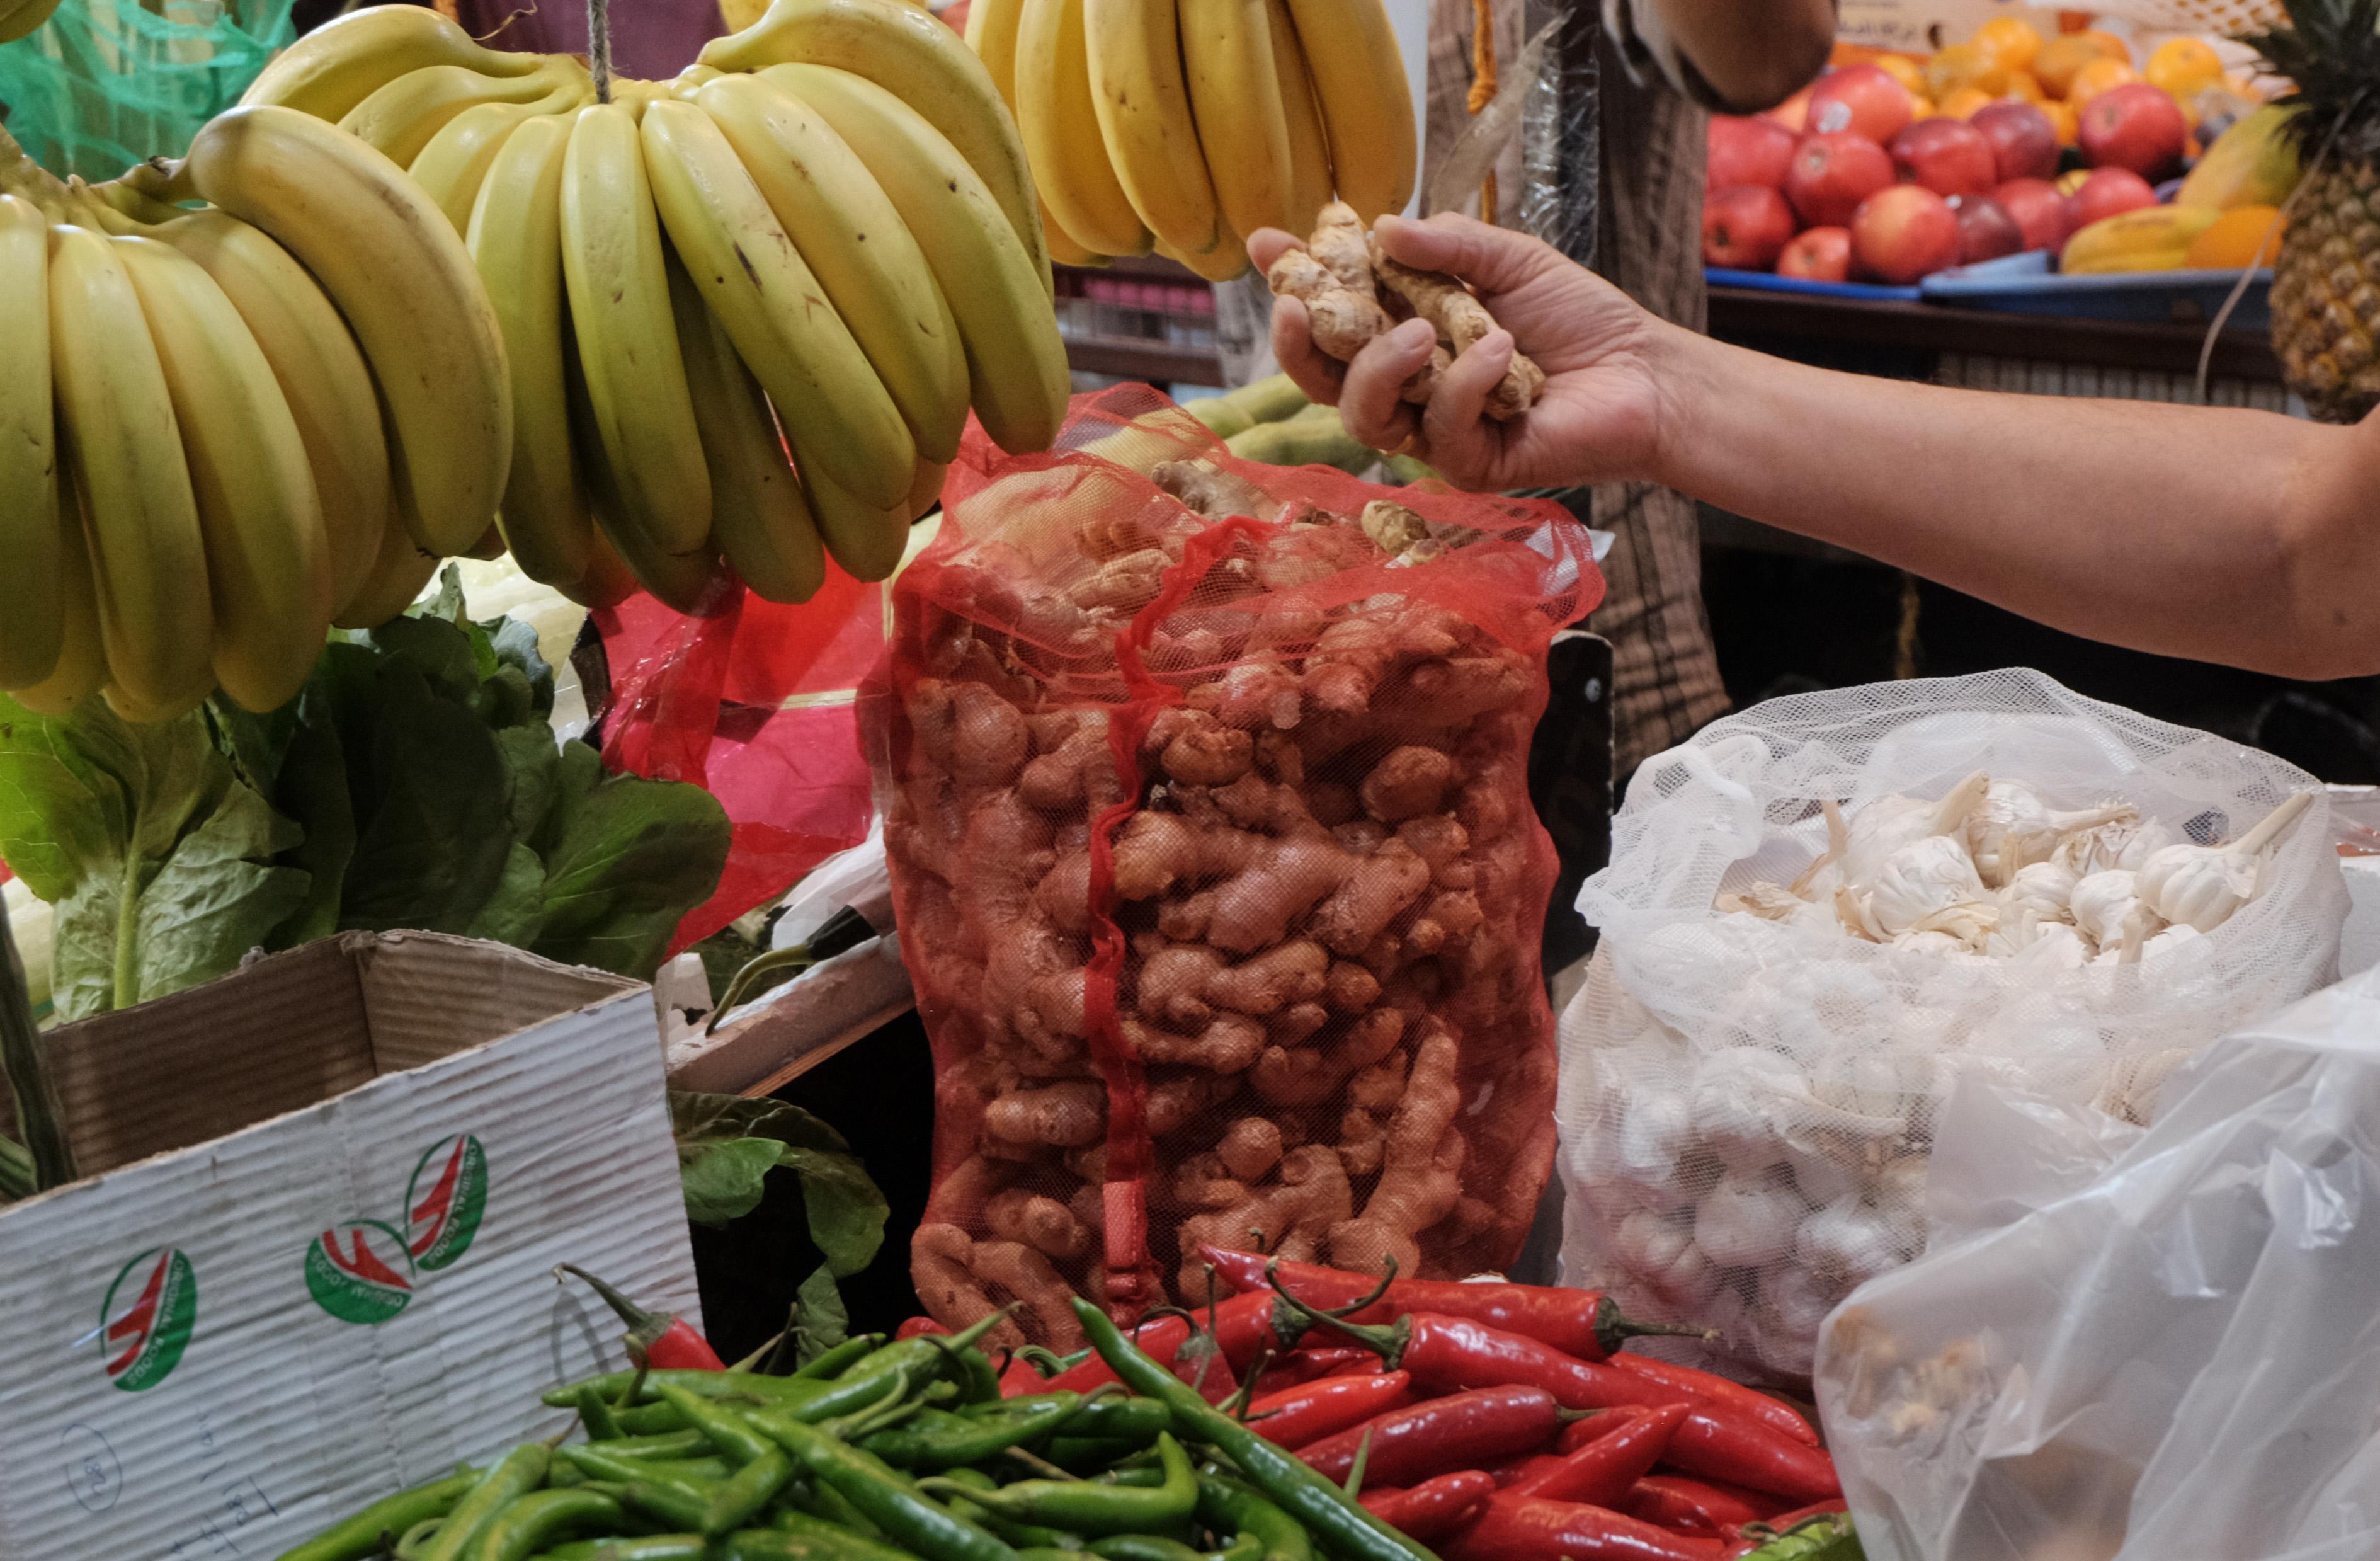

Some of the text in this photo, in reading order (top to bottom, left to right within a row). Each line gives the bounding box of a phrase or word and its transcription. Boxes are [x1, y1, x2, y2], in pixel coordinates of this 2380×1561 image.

[427, 1144, 479, 1264] ORIGINAL FOODS
[127, 1259, 185, 1385] ORIGINAL FOODS
[310, 1250, 404, 1307] ORIGINAL FOODS
